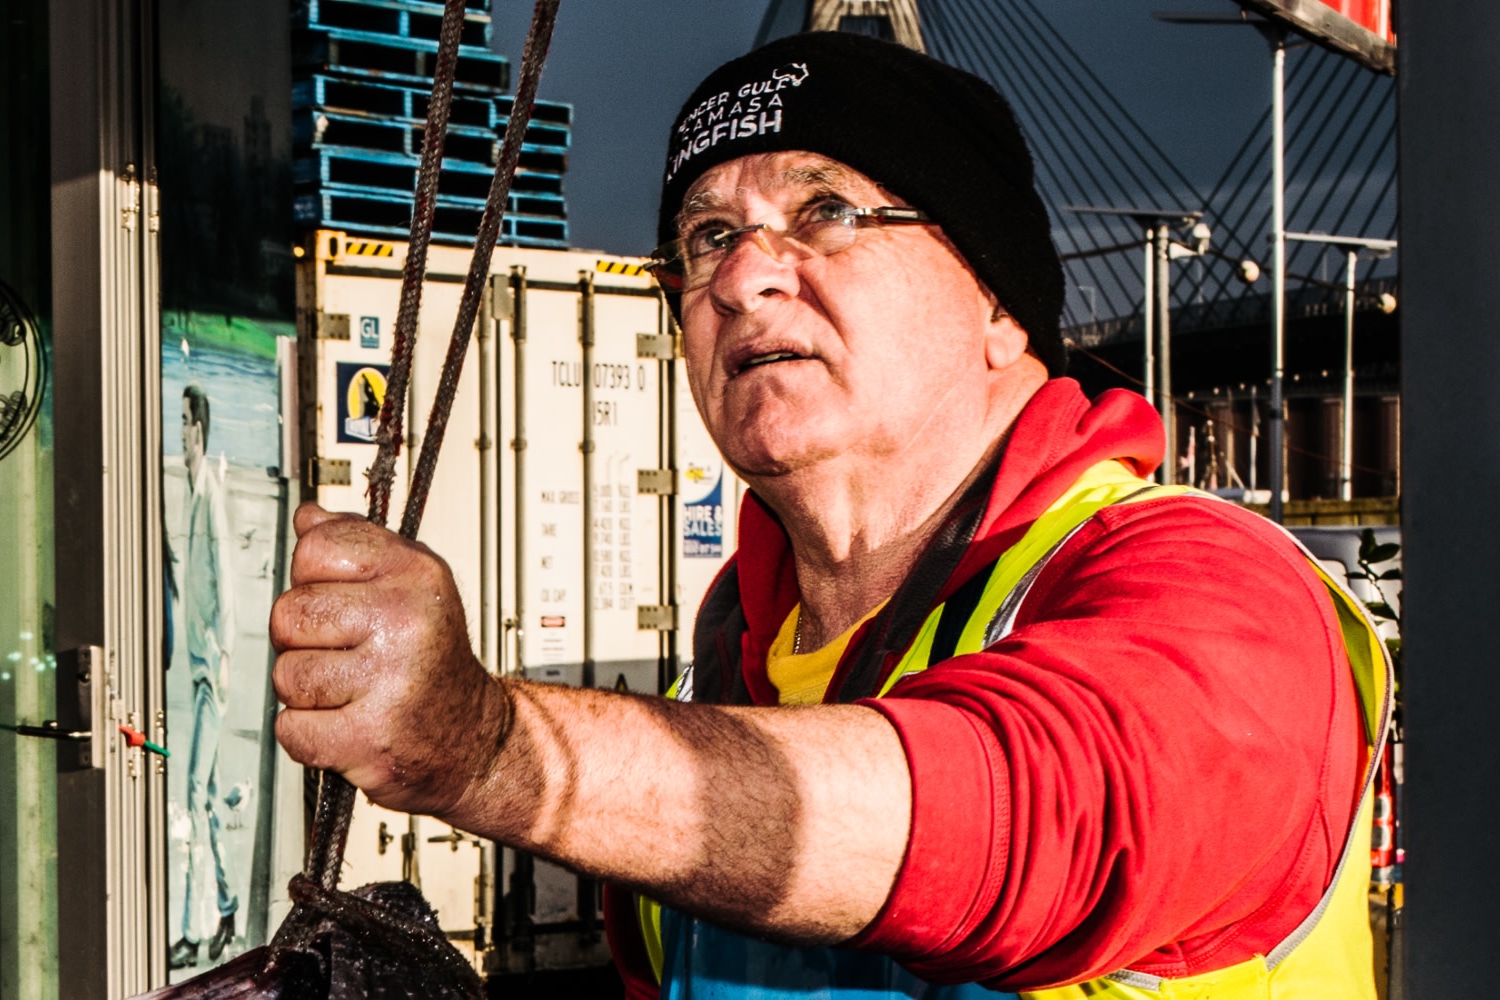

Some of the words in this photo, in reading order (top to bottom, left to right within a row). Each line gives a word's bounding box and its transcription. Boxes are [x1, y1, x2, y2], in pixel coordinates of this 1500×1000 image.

[361, 318, 379, 339] GL
[552, 360, 582, 387] TCLU
[593, 363, 631, 390] 07393
[637, 364, 646, 391] 0
[684, 505, 712, 521] HIRE
[684, 520, 722, 537] SALES
